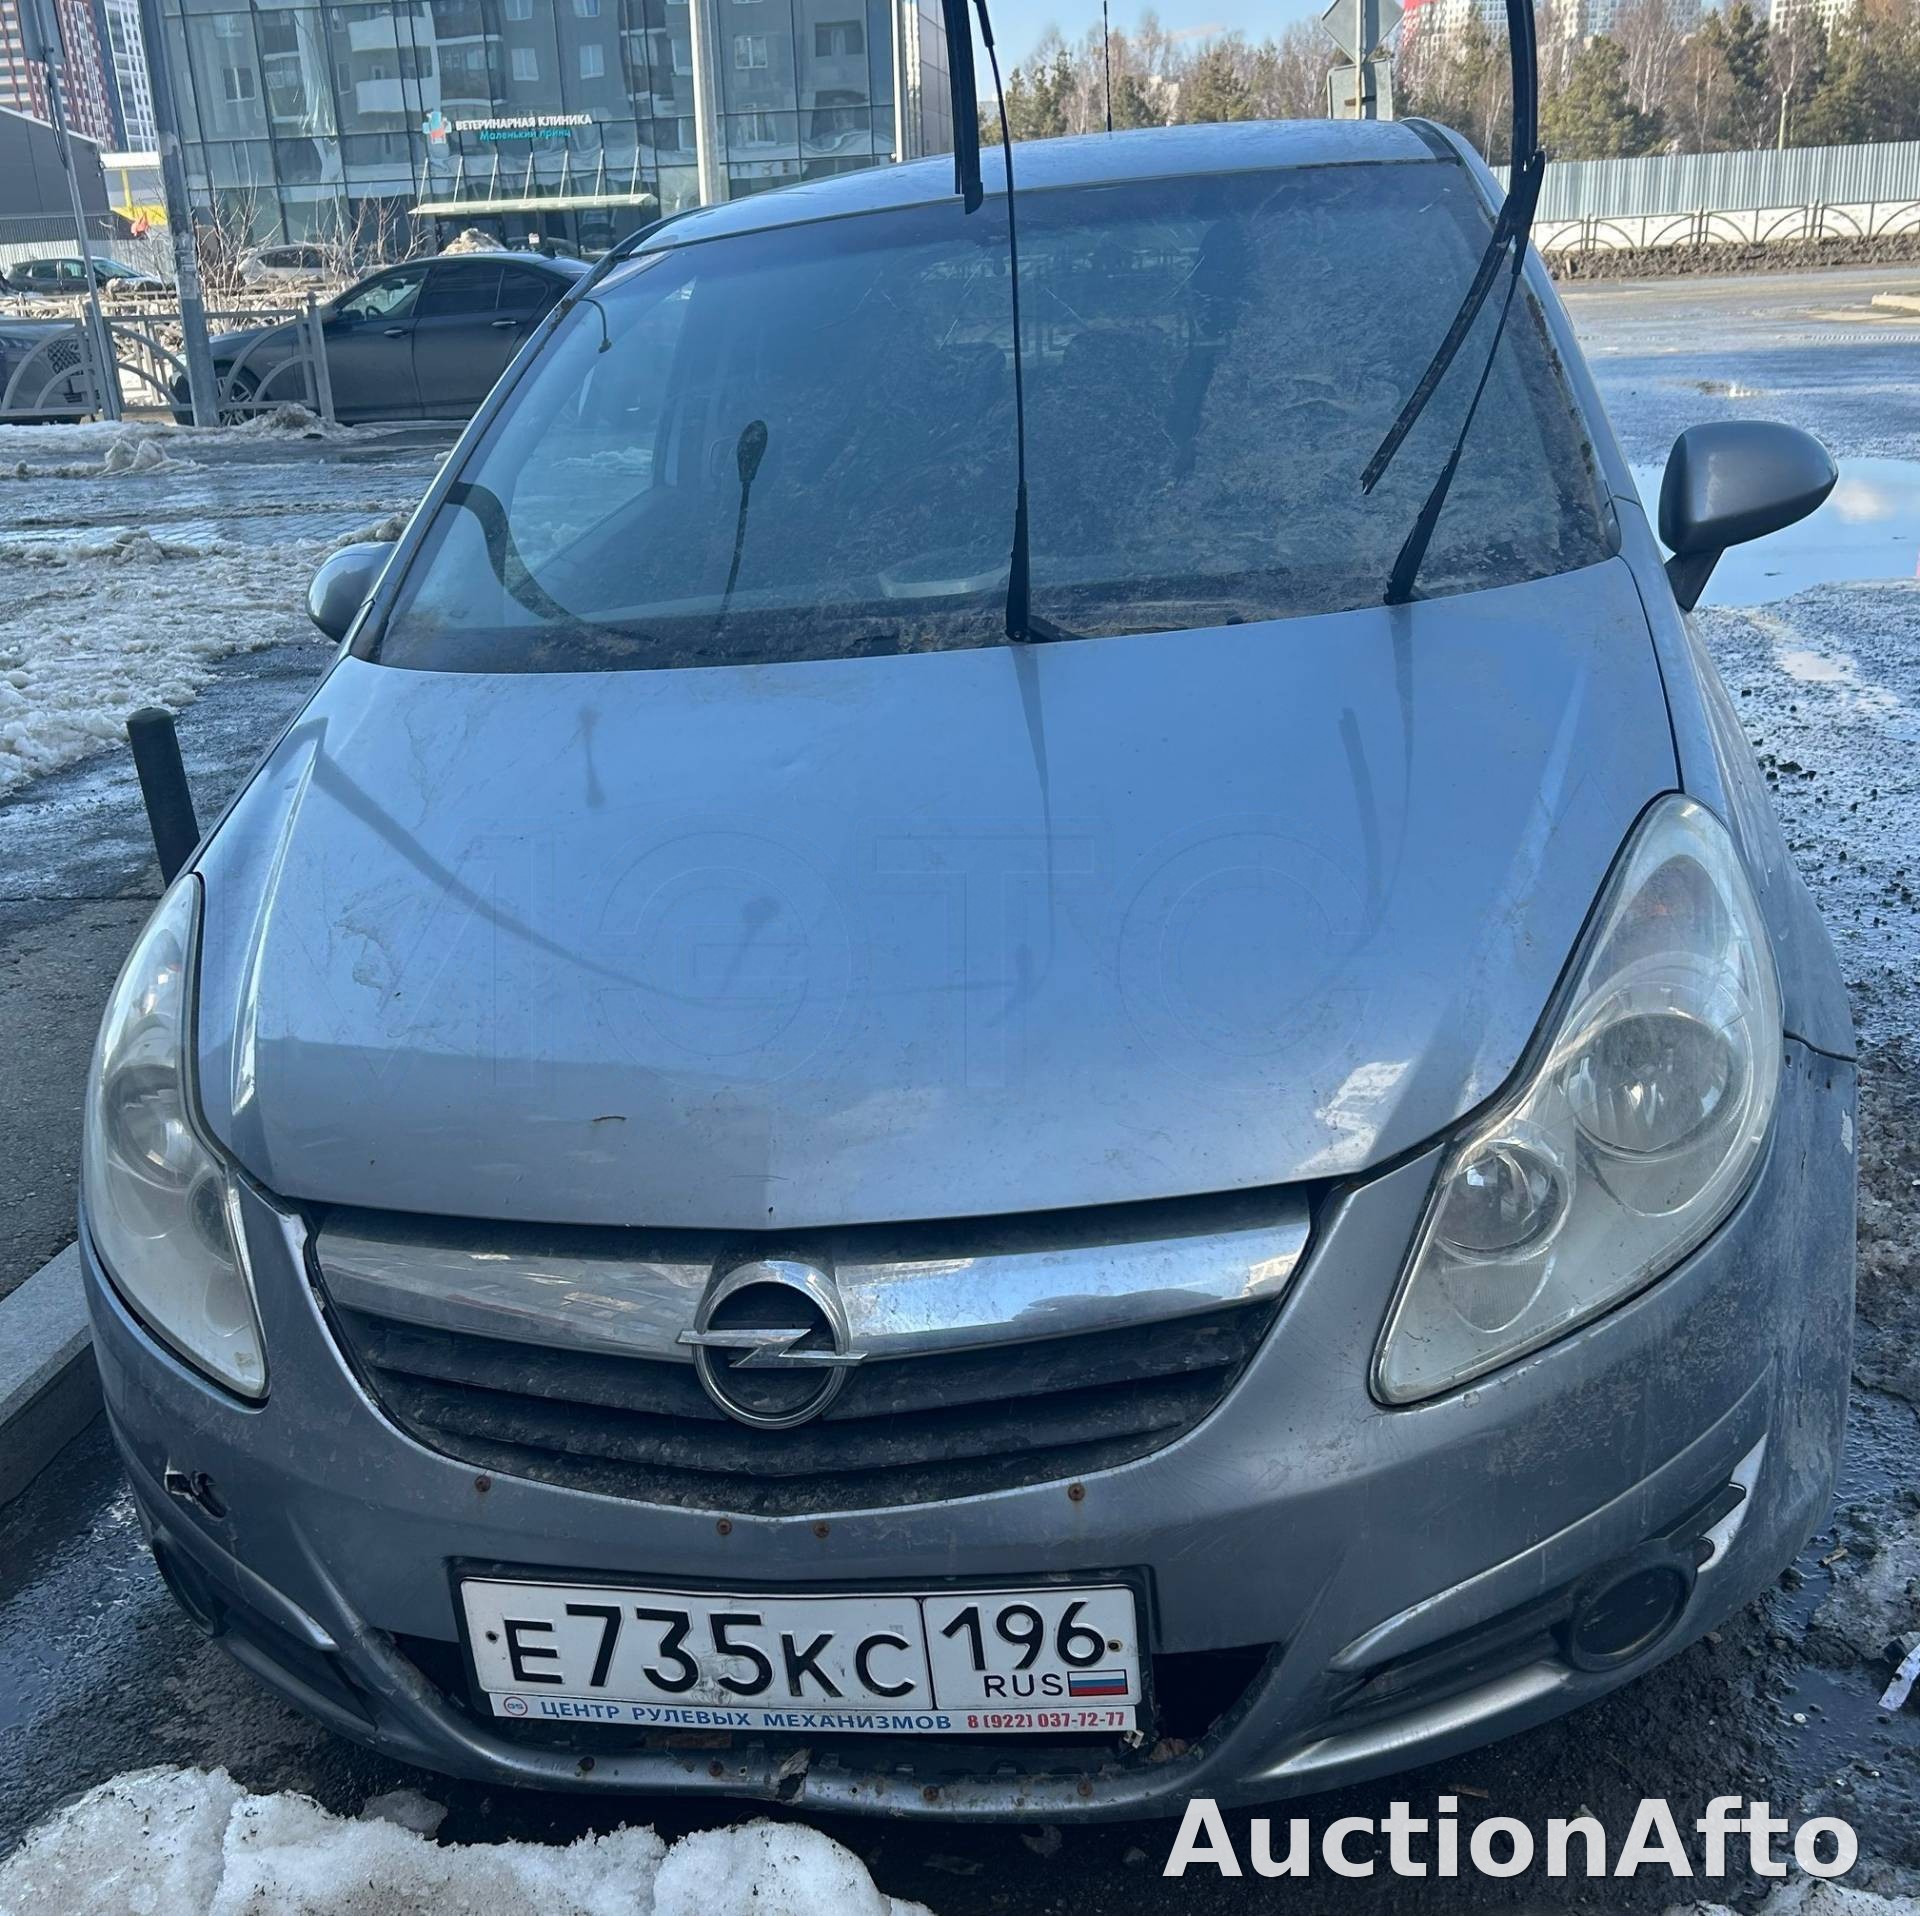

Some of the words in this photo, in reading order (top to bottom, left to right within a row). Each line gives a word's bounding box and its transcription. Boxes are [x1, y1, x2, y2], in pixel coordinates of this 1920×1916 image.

[455, 116, 536, 131] ВЕТЕРИНАРНАЯ
[537, 113, 592, 127] КЛИНИКА
[480, 128, 537, 141] Маленький
[940, 1599, 1106, 1671] 196
[983, 1673, 1064, 1698] RUS
[541, 1702, 620, 1719] ЦЕНТР
[632, 1707, 751, 1726] РУЛЕВЫХ
[763, 1713, 952, 1730] МЕХАНИЗМОВ
[967, 1715, 979, 1729] 8
[983, 1714, 1033, 1729] (922)
[1037, 1711, 1125, 1728] 037-72-77
